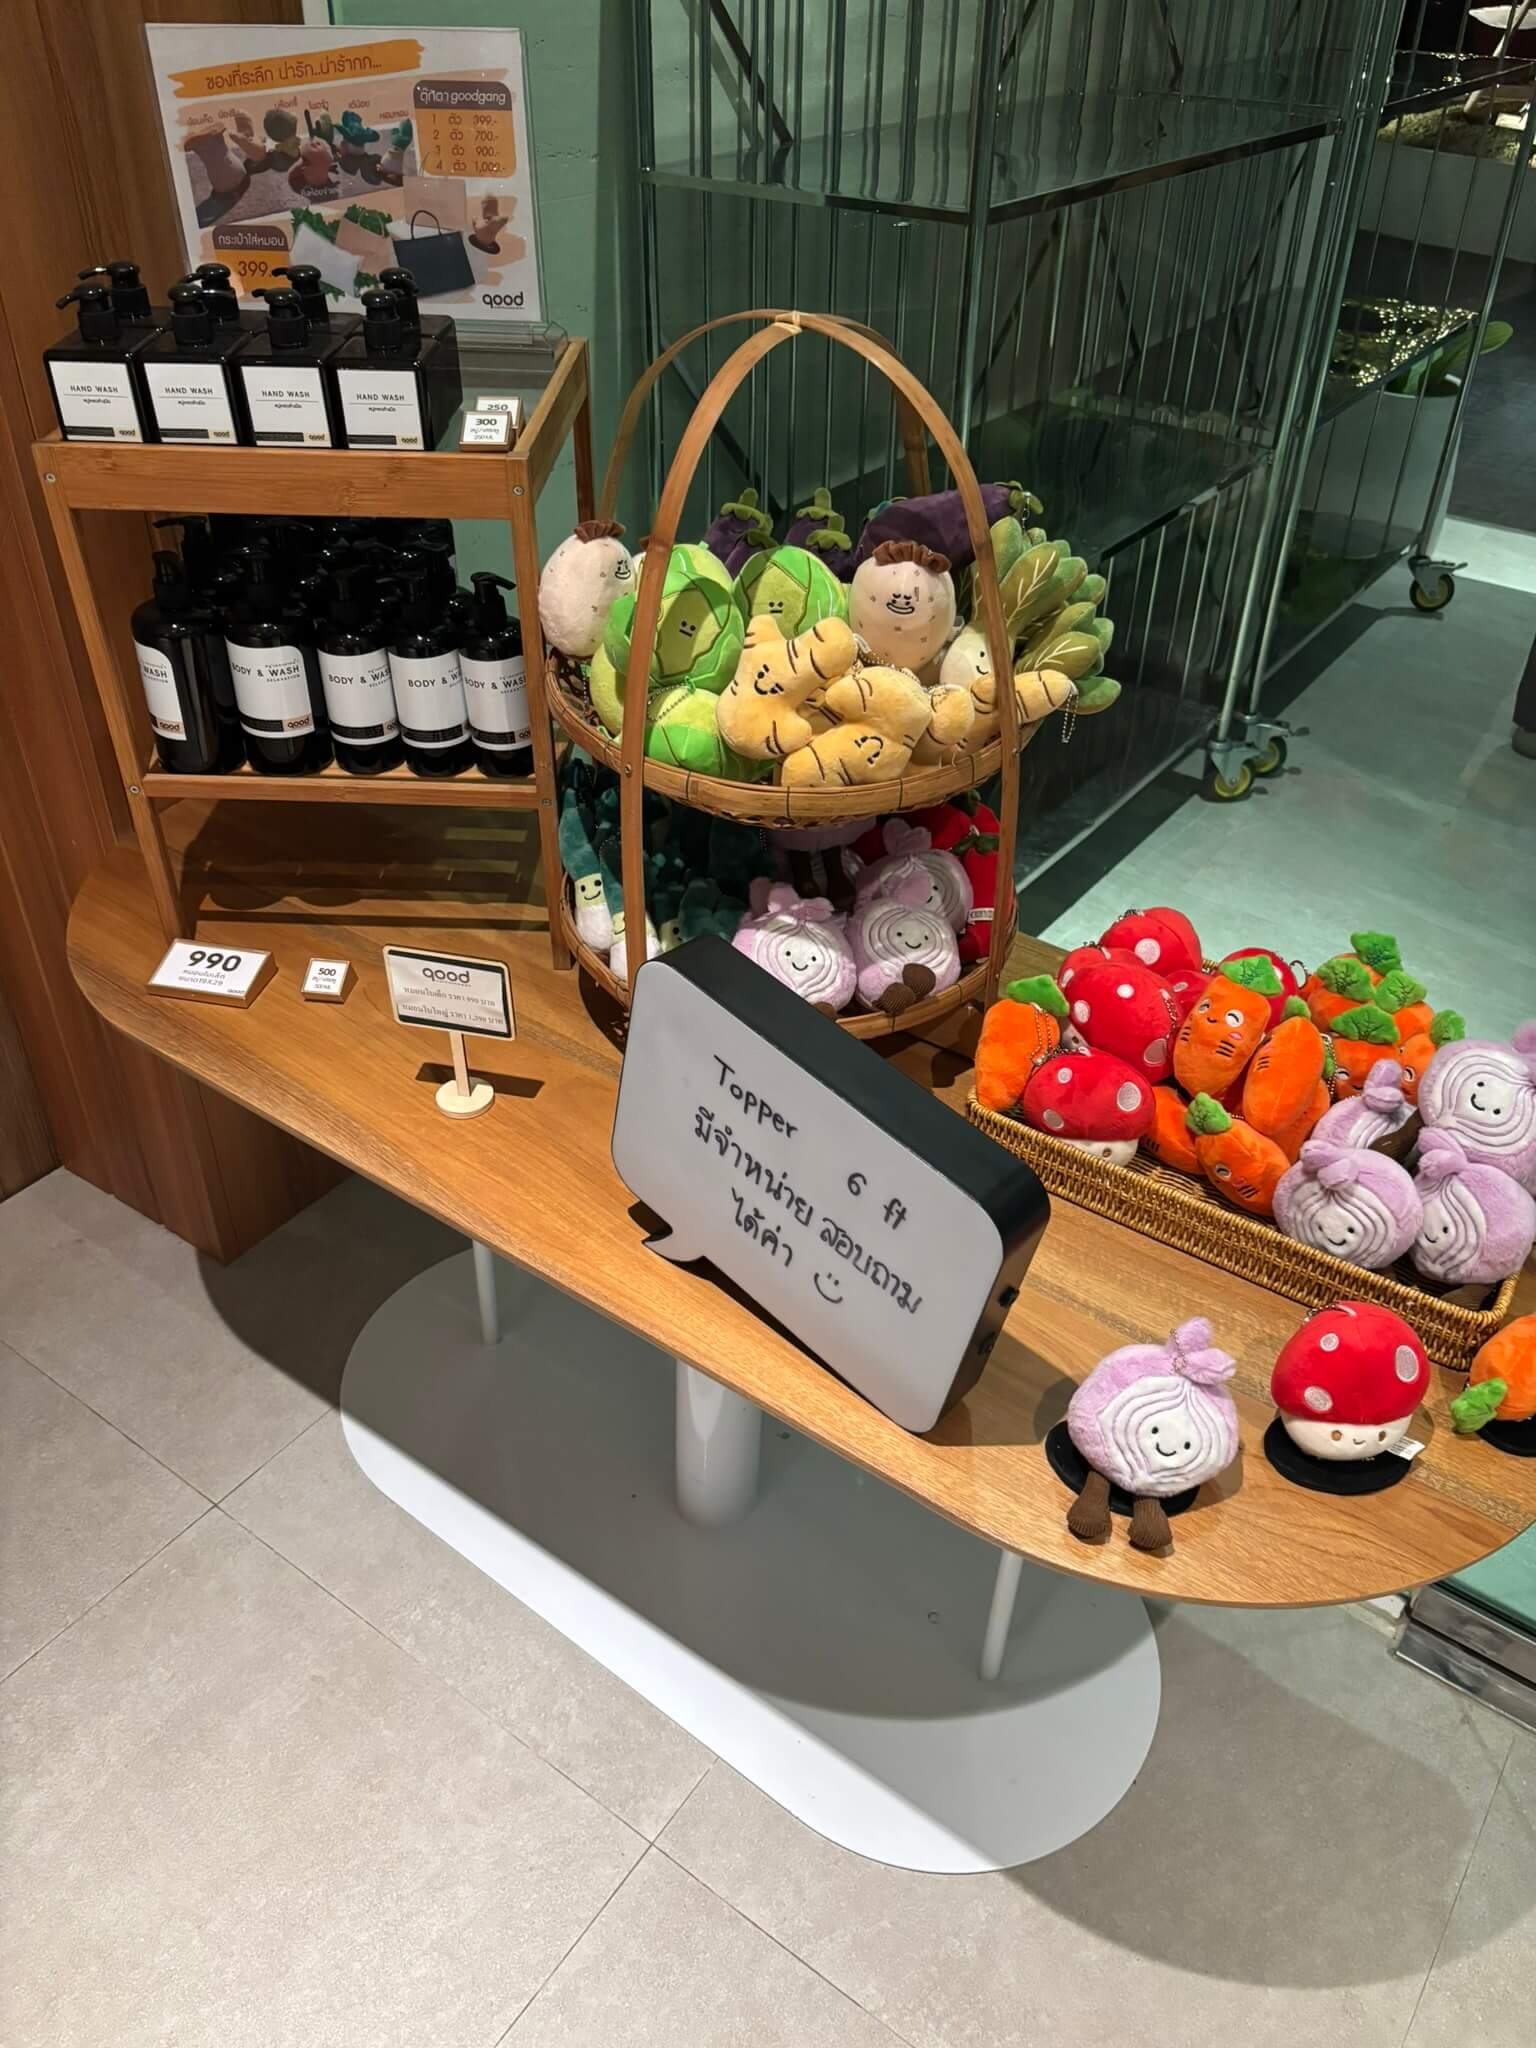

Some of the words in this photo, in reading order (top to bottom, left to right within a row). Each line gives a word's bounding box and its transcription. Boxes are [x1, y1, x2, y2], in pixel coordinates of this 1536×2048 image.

[206, 64, 273, 90] ของที่ระลึก
[420, 88, 449, 104] ตุ๊กตา
[451, 89, 506, 105] goodgang
[448, 113, 462, 125] ตัว
[433, 129, 439, 140] 2
[449, 128, 463, 140] ตัว
[451, 144, 464, 156] ตัว
[70, 385, 93, 393] HAND
[190, 387, 214, 395] WASH
[262, 390, 284, 398] HAND
[356, 393, 379, 401] HAND
[475, 418, 497, 426] 300
[257, 669, 264, 677] &
[269, 664, 300, 677] WASH
[328, 674, 353, 685] BODY
[360, 676, 367, 684] &
[370, 668, 390, 681] WAS
[408, 679, 435, 688] BODY
[441, 676, 448, 685] &
[491, 682, 498, 690] &
[188, 950, 242, 972] 990
[318, 967, 337, 976] 500
[712, 1054, 799, 1139] Topper
[847, 1172, 868, 1197] 6
[882, 1197, 908, 1231] ft
[694, 1106, 814, 1226] มีจำหน่าย
[820, 1216, 924, 1314] สอบถาม
[731, 1187, 794, 1268] ได้ค่า
